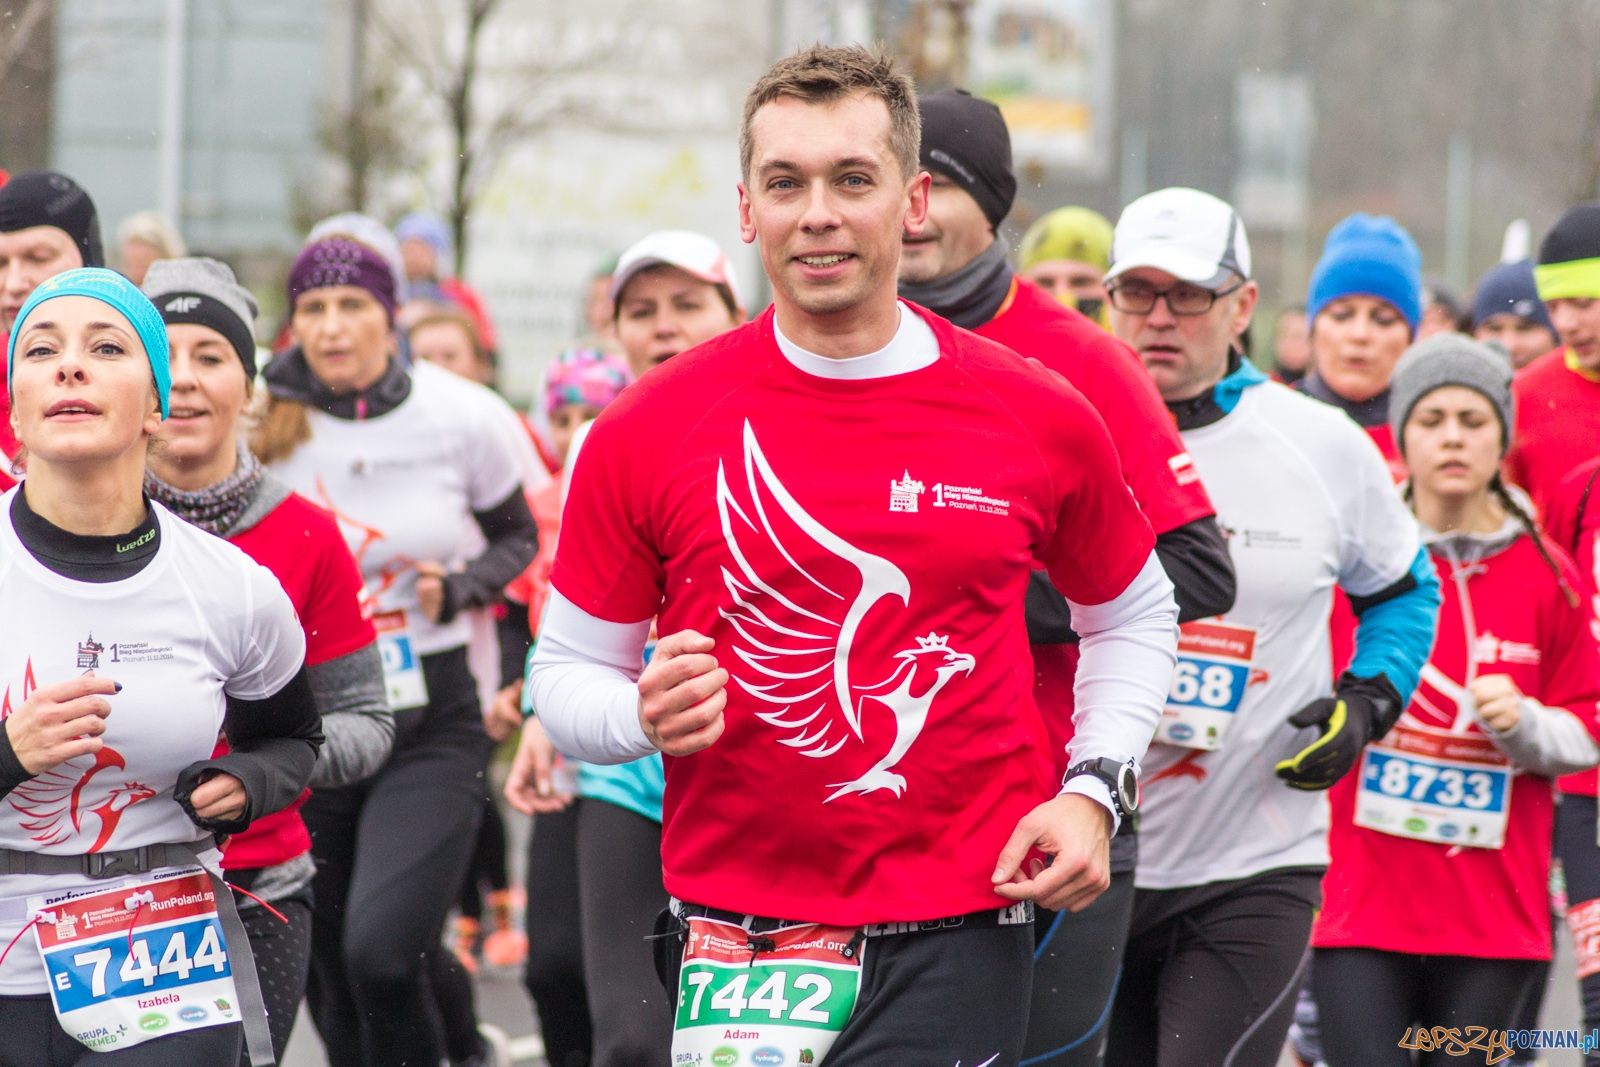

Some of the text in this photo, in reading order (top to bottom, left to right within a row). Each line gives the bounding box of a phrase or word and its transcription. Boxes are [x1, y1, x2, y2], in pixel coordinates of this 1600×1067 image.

[931, 482, 946, 507] 1
[944, 485, 982, 495] Poznański
[944, 492, 961, 500] Bieg
[979, 504, 1009, 516] 11.11.2016
[109, 643, 121, 663] 1
[1379, 758, 1493, 809] 8733
[150, 890, 215, 912] RunPoland.org
[81, 911, 94, 930] 1
[701, 934, 711, 950] 1
[73, 924, 228, 999] 7444
[55, 971, 72, 991] E
[137, 992, 181, 1010] Izabela
[687, 970, 833, 1025] 7442
[76, 1027, 109, 1041] GRUPA
[723, 1029, 760, 1040] Adam
